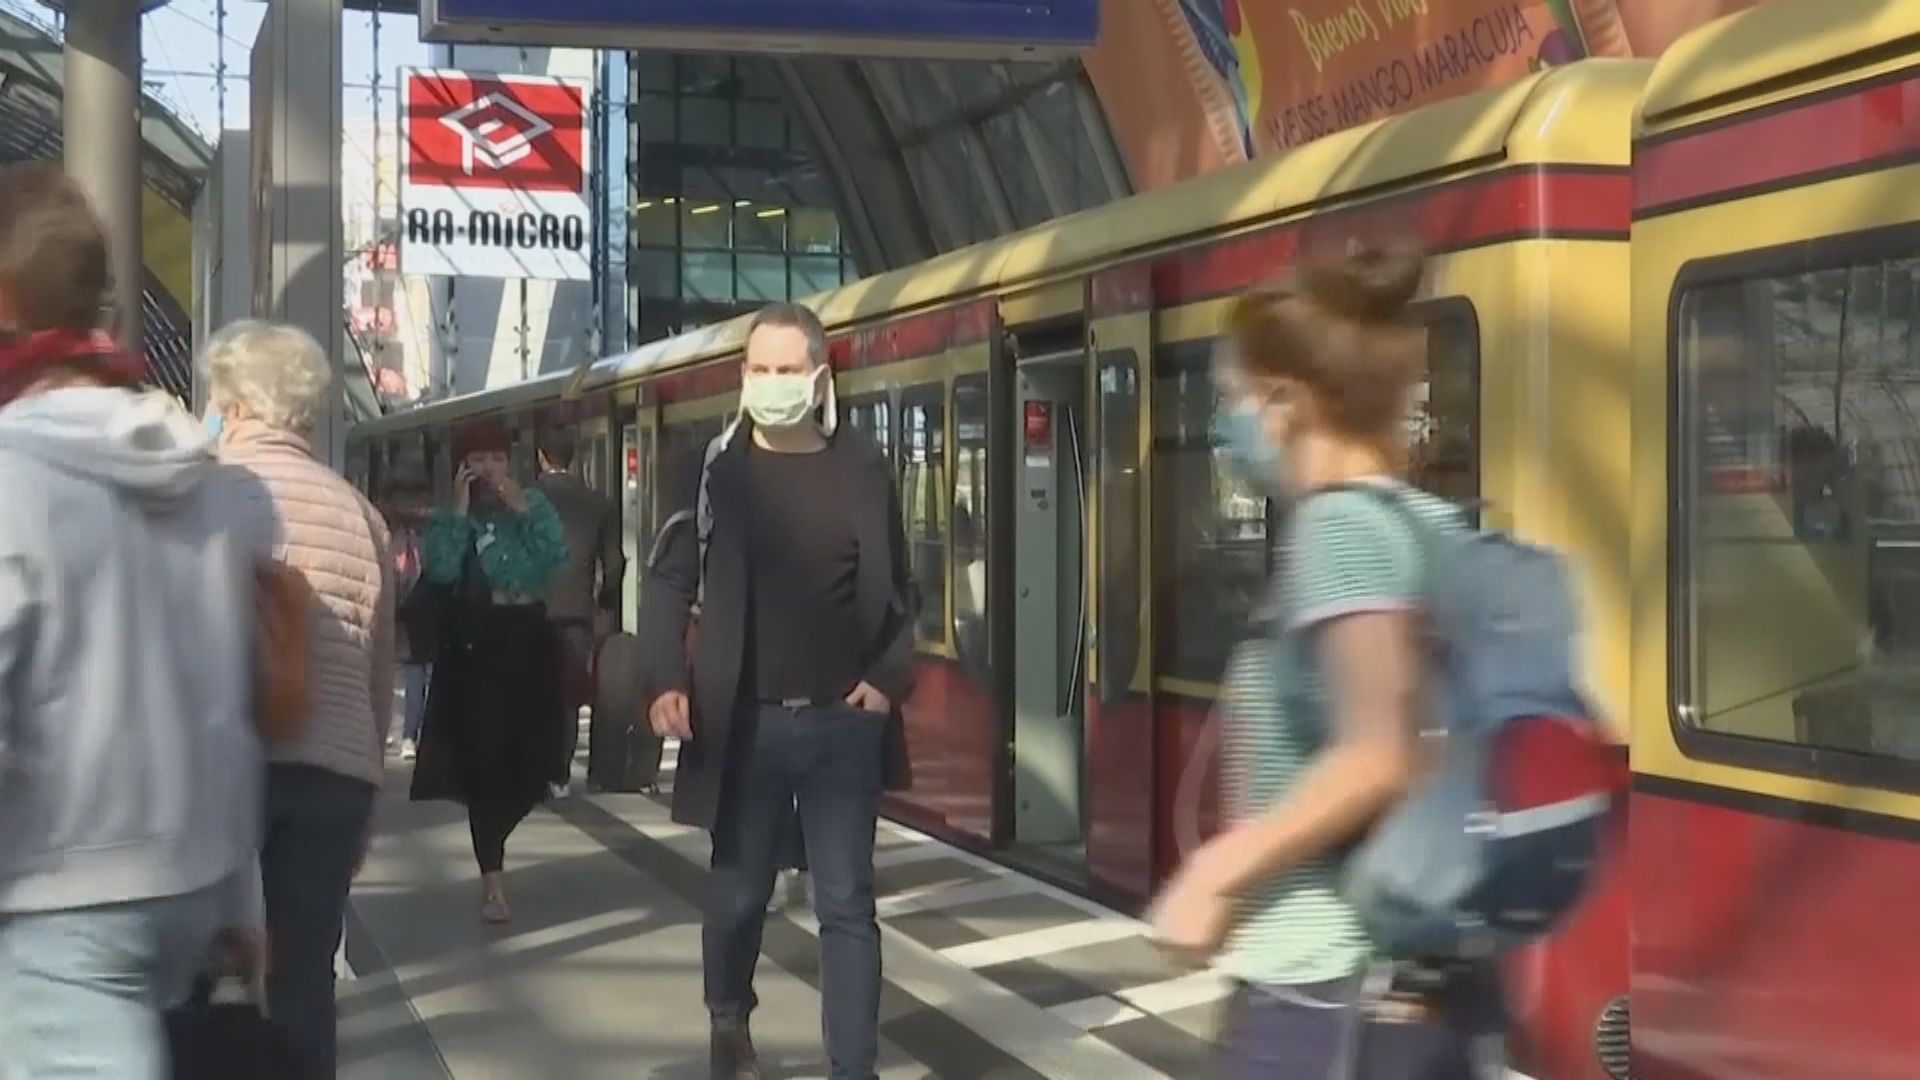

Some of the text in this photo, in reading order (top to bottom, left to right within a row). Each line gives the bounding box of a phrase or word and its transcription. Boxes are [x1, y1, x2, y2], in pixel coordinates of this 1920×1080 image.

[1267, 94, 1332, 151] WEISSE
[1331, 60, 1413, 128] MANGO
[1413, 4, 1535, 93] MARACUJA
[1287, 0, 1379, 72] Buenos
